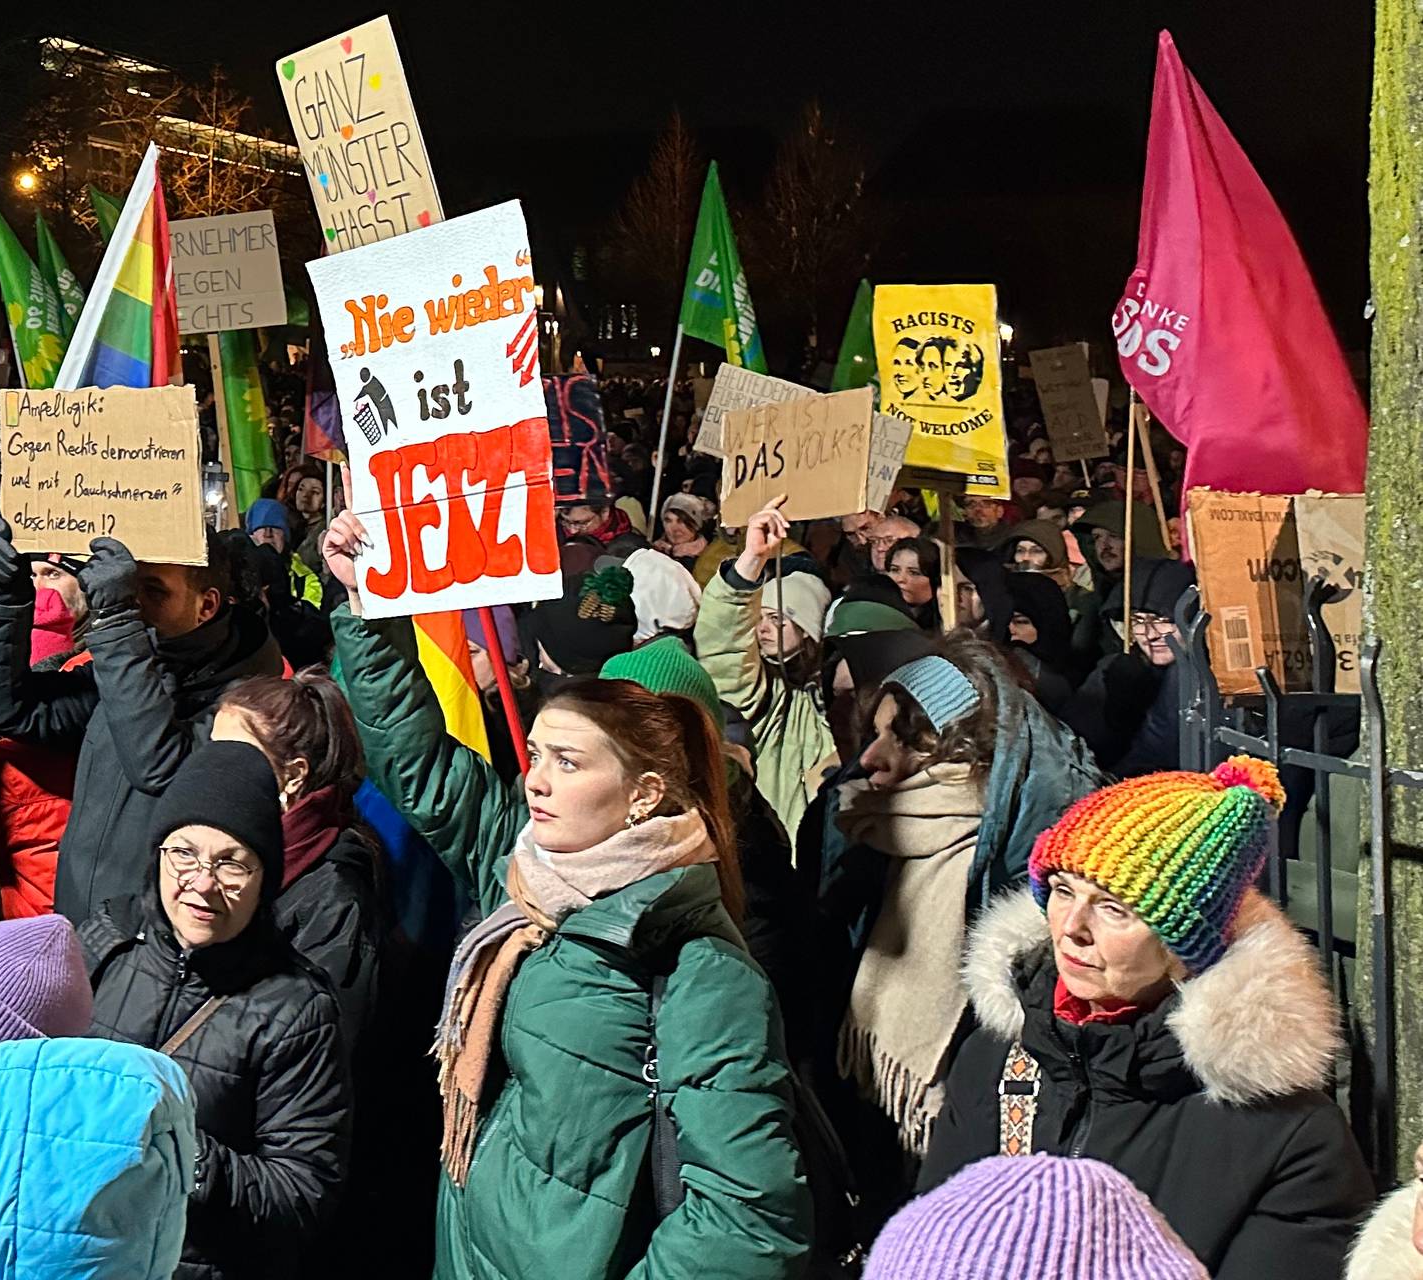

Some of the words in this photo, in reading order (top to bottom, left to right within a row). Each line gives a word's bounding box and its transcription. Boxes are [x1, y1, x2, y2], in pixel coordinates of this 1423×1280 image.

[295, 53, 385, 140] GANZ
[303, 121, 422, 202] MÜNSTER
[169, 223, 276, 258] RNEHMER
[173, 267, 242, 296] EGEN
[176, 301, 254, 332] ECHTS
[890, 311, 976, 335] RACISTS
[1111, 298, 1182, 377] SDS
[413, 358, 473, 421] ist
[19, 391, 106, 427] Ampellogik:
[919, 408, 994, 436] WELCOME
[7, 431, 51, 463] Gegen
[56, 428, 98, 457] Rechts
[100, 434, 186, 461] demonstrieren
[727, 403, 780, 453] WER
[11, 467, 31, 489] und
[38, 470, 60, 491] mit
[734, 439, 786, 490] DAS
[14, 502, 96, 535] abschieben
[367, 417, 562, 600] JETZT
